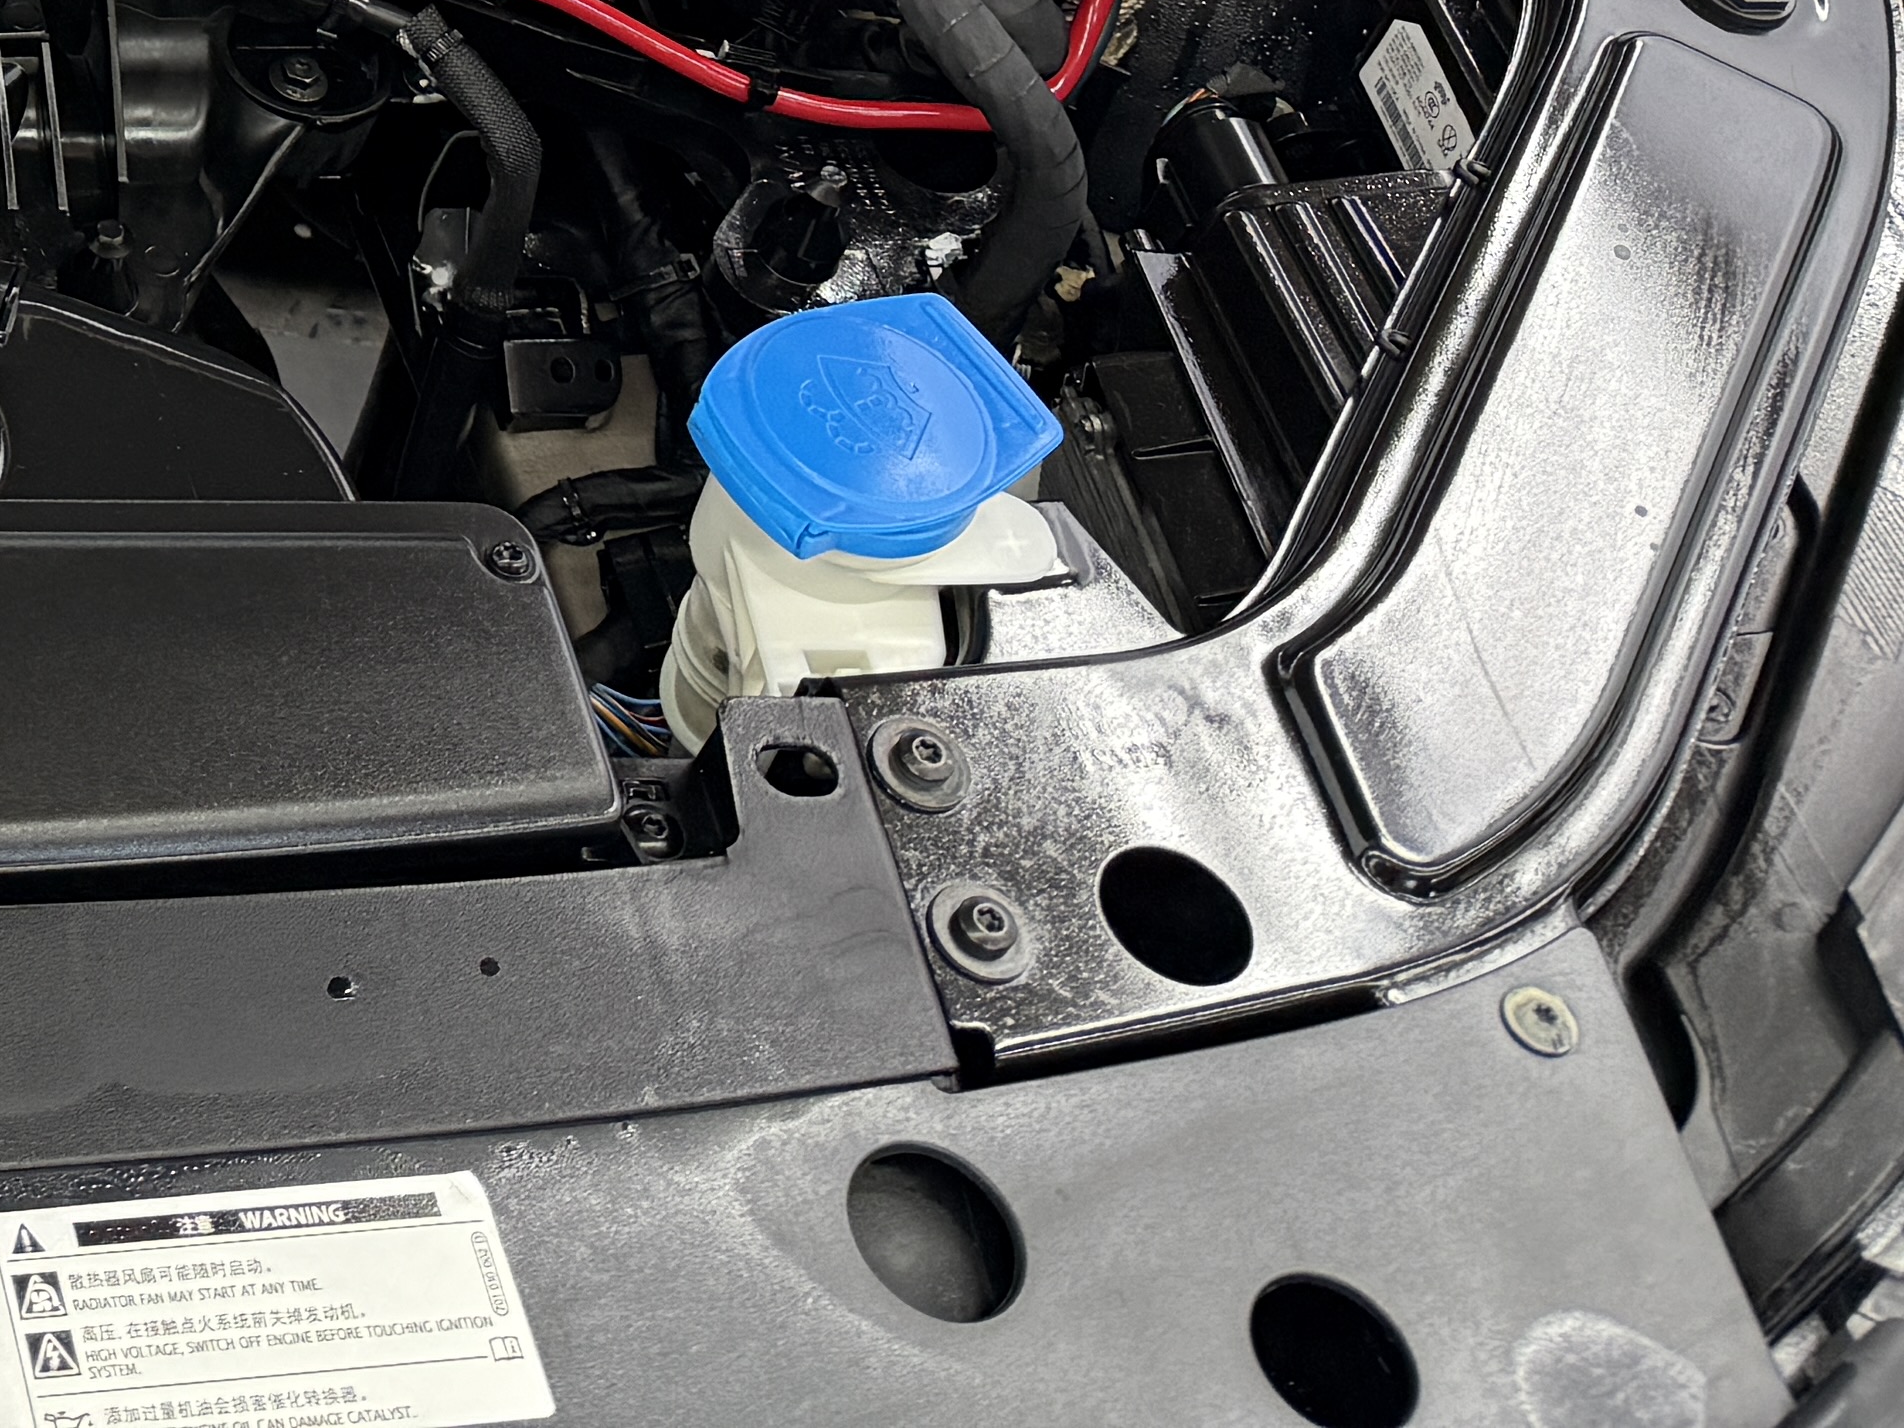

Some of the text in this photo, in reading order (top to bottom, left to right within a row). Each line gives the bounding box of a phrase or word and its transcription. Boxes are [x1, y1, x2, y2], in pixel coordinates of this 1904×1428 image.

[176, 1215, 215, 1234] 注意
[238, 1204, 346, 1230] WARNING
[73, 1295, 137, 1311] RADIATOR
[140, 1293, 164, 1305] FAN
[168, 1289, 193, 1302] MAY
[197, 1285, 236, 1301] START
[241, 1283, 257, 1297] AT
[261, 1280, 285, 1295] ANY
[85, 1316, 494, 1363] HIGH VOLTAGE, SWITCH OFF ENGINE BEFORE TOUCHING IGNITION
[88, 1363, 143, 1380] SYSTEM.
[288, 1412, 344, 1428] DAMAGE
